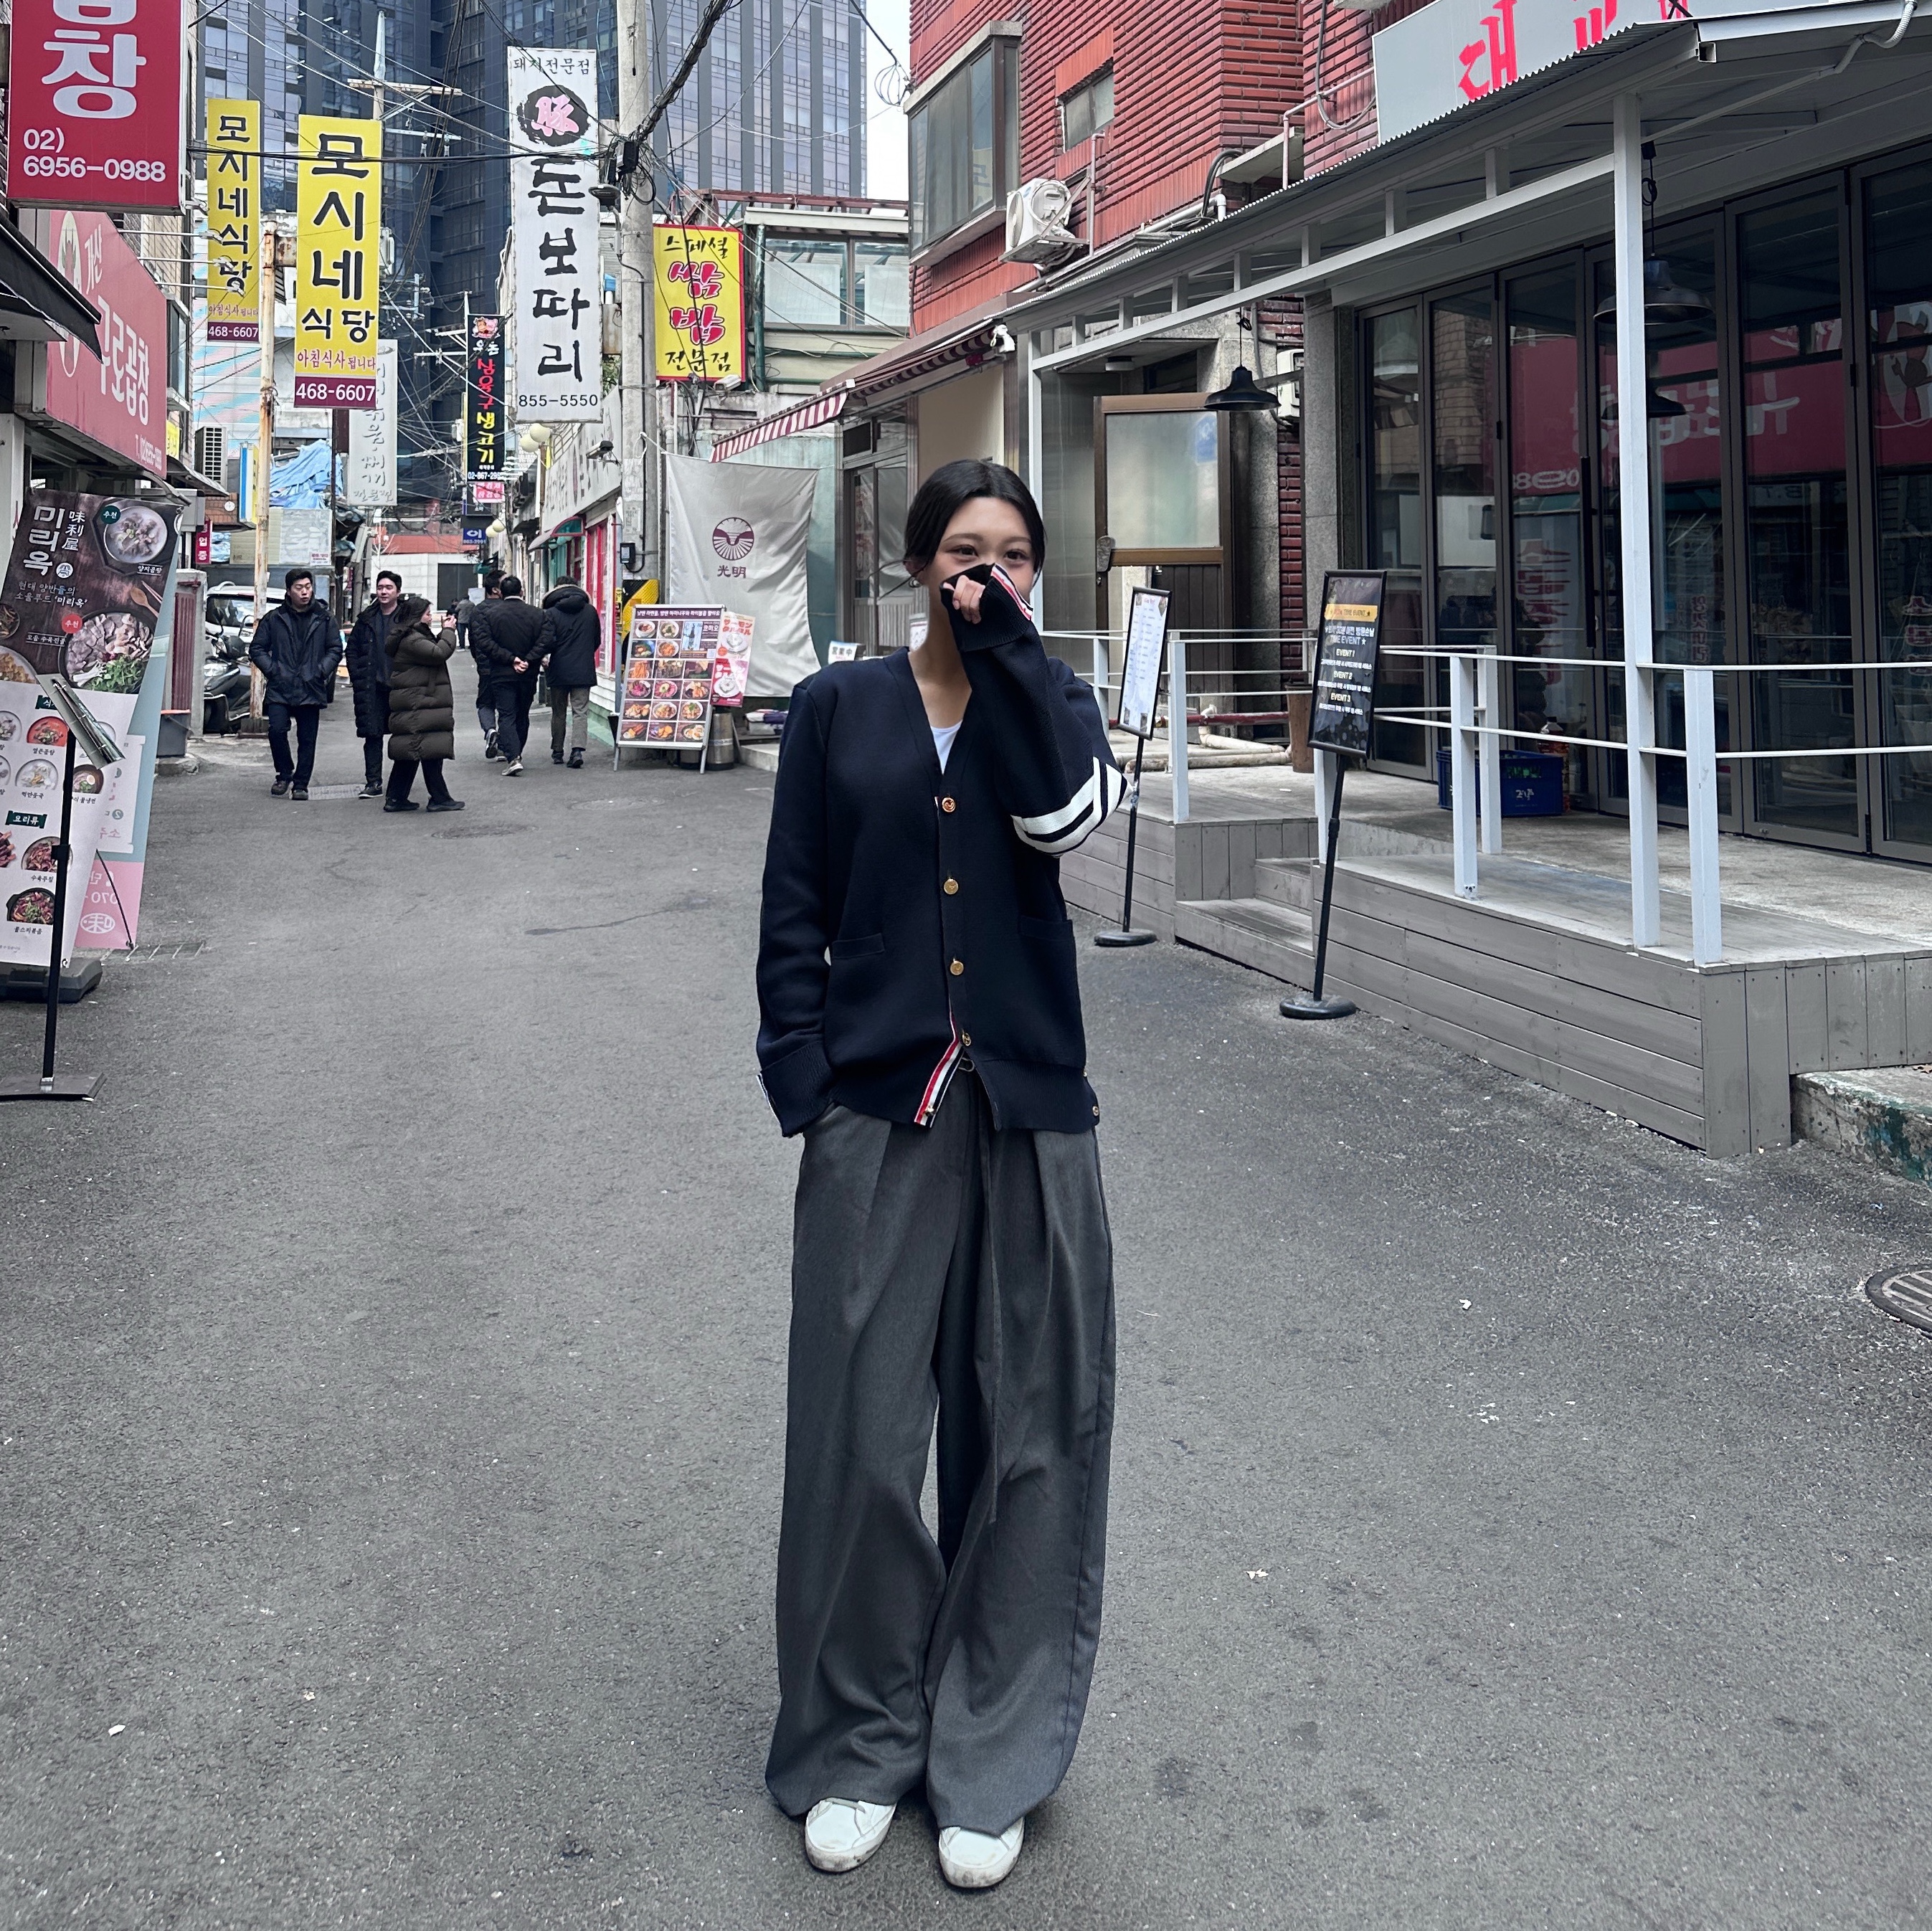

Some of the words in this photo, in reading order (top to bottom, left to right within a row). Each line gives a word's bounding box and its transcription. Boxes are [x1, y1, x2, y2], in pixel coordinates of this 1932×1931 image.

[513, 57, 589, 75] 돼지전문점
[23, 127, 65, 153] 02)
[23, 155, 166, 182] 6956-0988
[311, 133, 369, 300] 모시네
[663, 235, 728, 259] 스페셜
[528, 158, 590, 382] 돈보따리
[208, 304, 240, 317] 아침식사
[208, 326, 259, 338] 468-6607
[301, 308, 376, 343] 식당
[298, 349, 346, 369] 아침식사
[348, 356, 377, 370] 됩니다
[665, 348, 731, 372] 전문점
[295, 383, 376, 402] 468-6607
[518, 394, 599, 407] 855-5550
[477, 412, 496, 464] 생고기
[23, 506, 66, 577] 미리옥
[717, 564, 747, 579] 光明
[19, 581, 36, 592] 현대
[13, 815, 39, 825] 요리류
